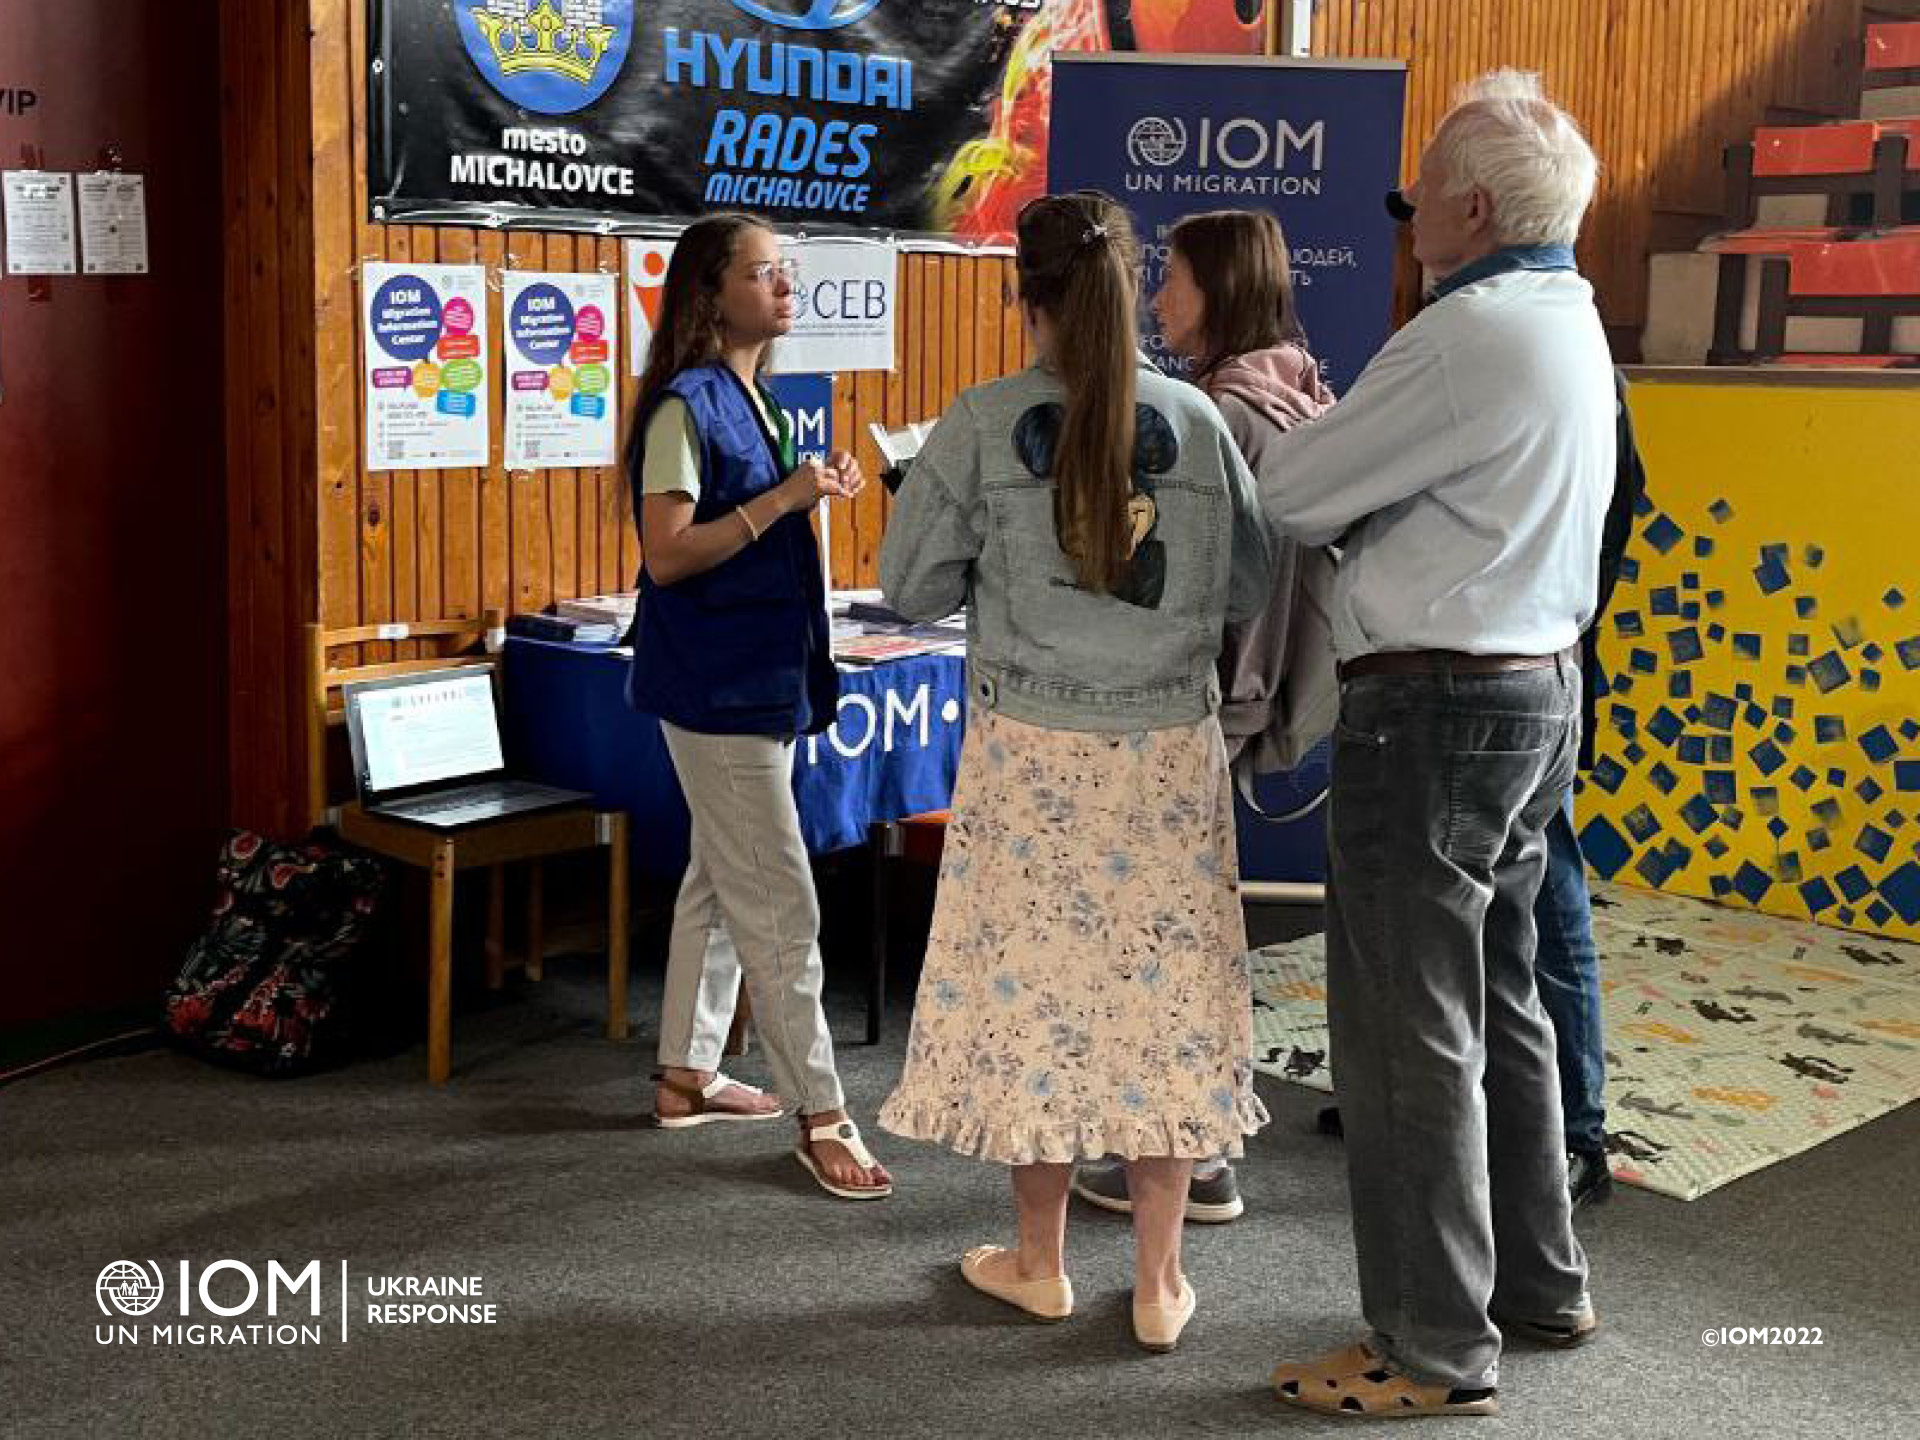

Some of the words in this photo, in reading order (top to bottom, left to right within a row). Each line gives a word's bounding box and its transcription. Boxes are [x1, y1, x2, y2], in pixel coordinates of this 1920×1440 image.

[663, 27, 913, 111] HYUNDAI
[0, 88, 36, 116] IP
[503, 127, 586, 156] mesto
[704, 109, 879, 178] RADES
[1199, 117, 1325, 170] IOM
[451, 155, 634, 195] MICHALOVCE
[704, 172, 870, 212] MICHALOVCE
[1125, 173, 1163, 190] UN
[1173, 174, 1321, 195] MIGRATION
[389, 289, 421, 304] IOM
[813, 279, 887, 319] CEB
